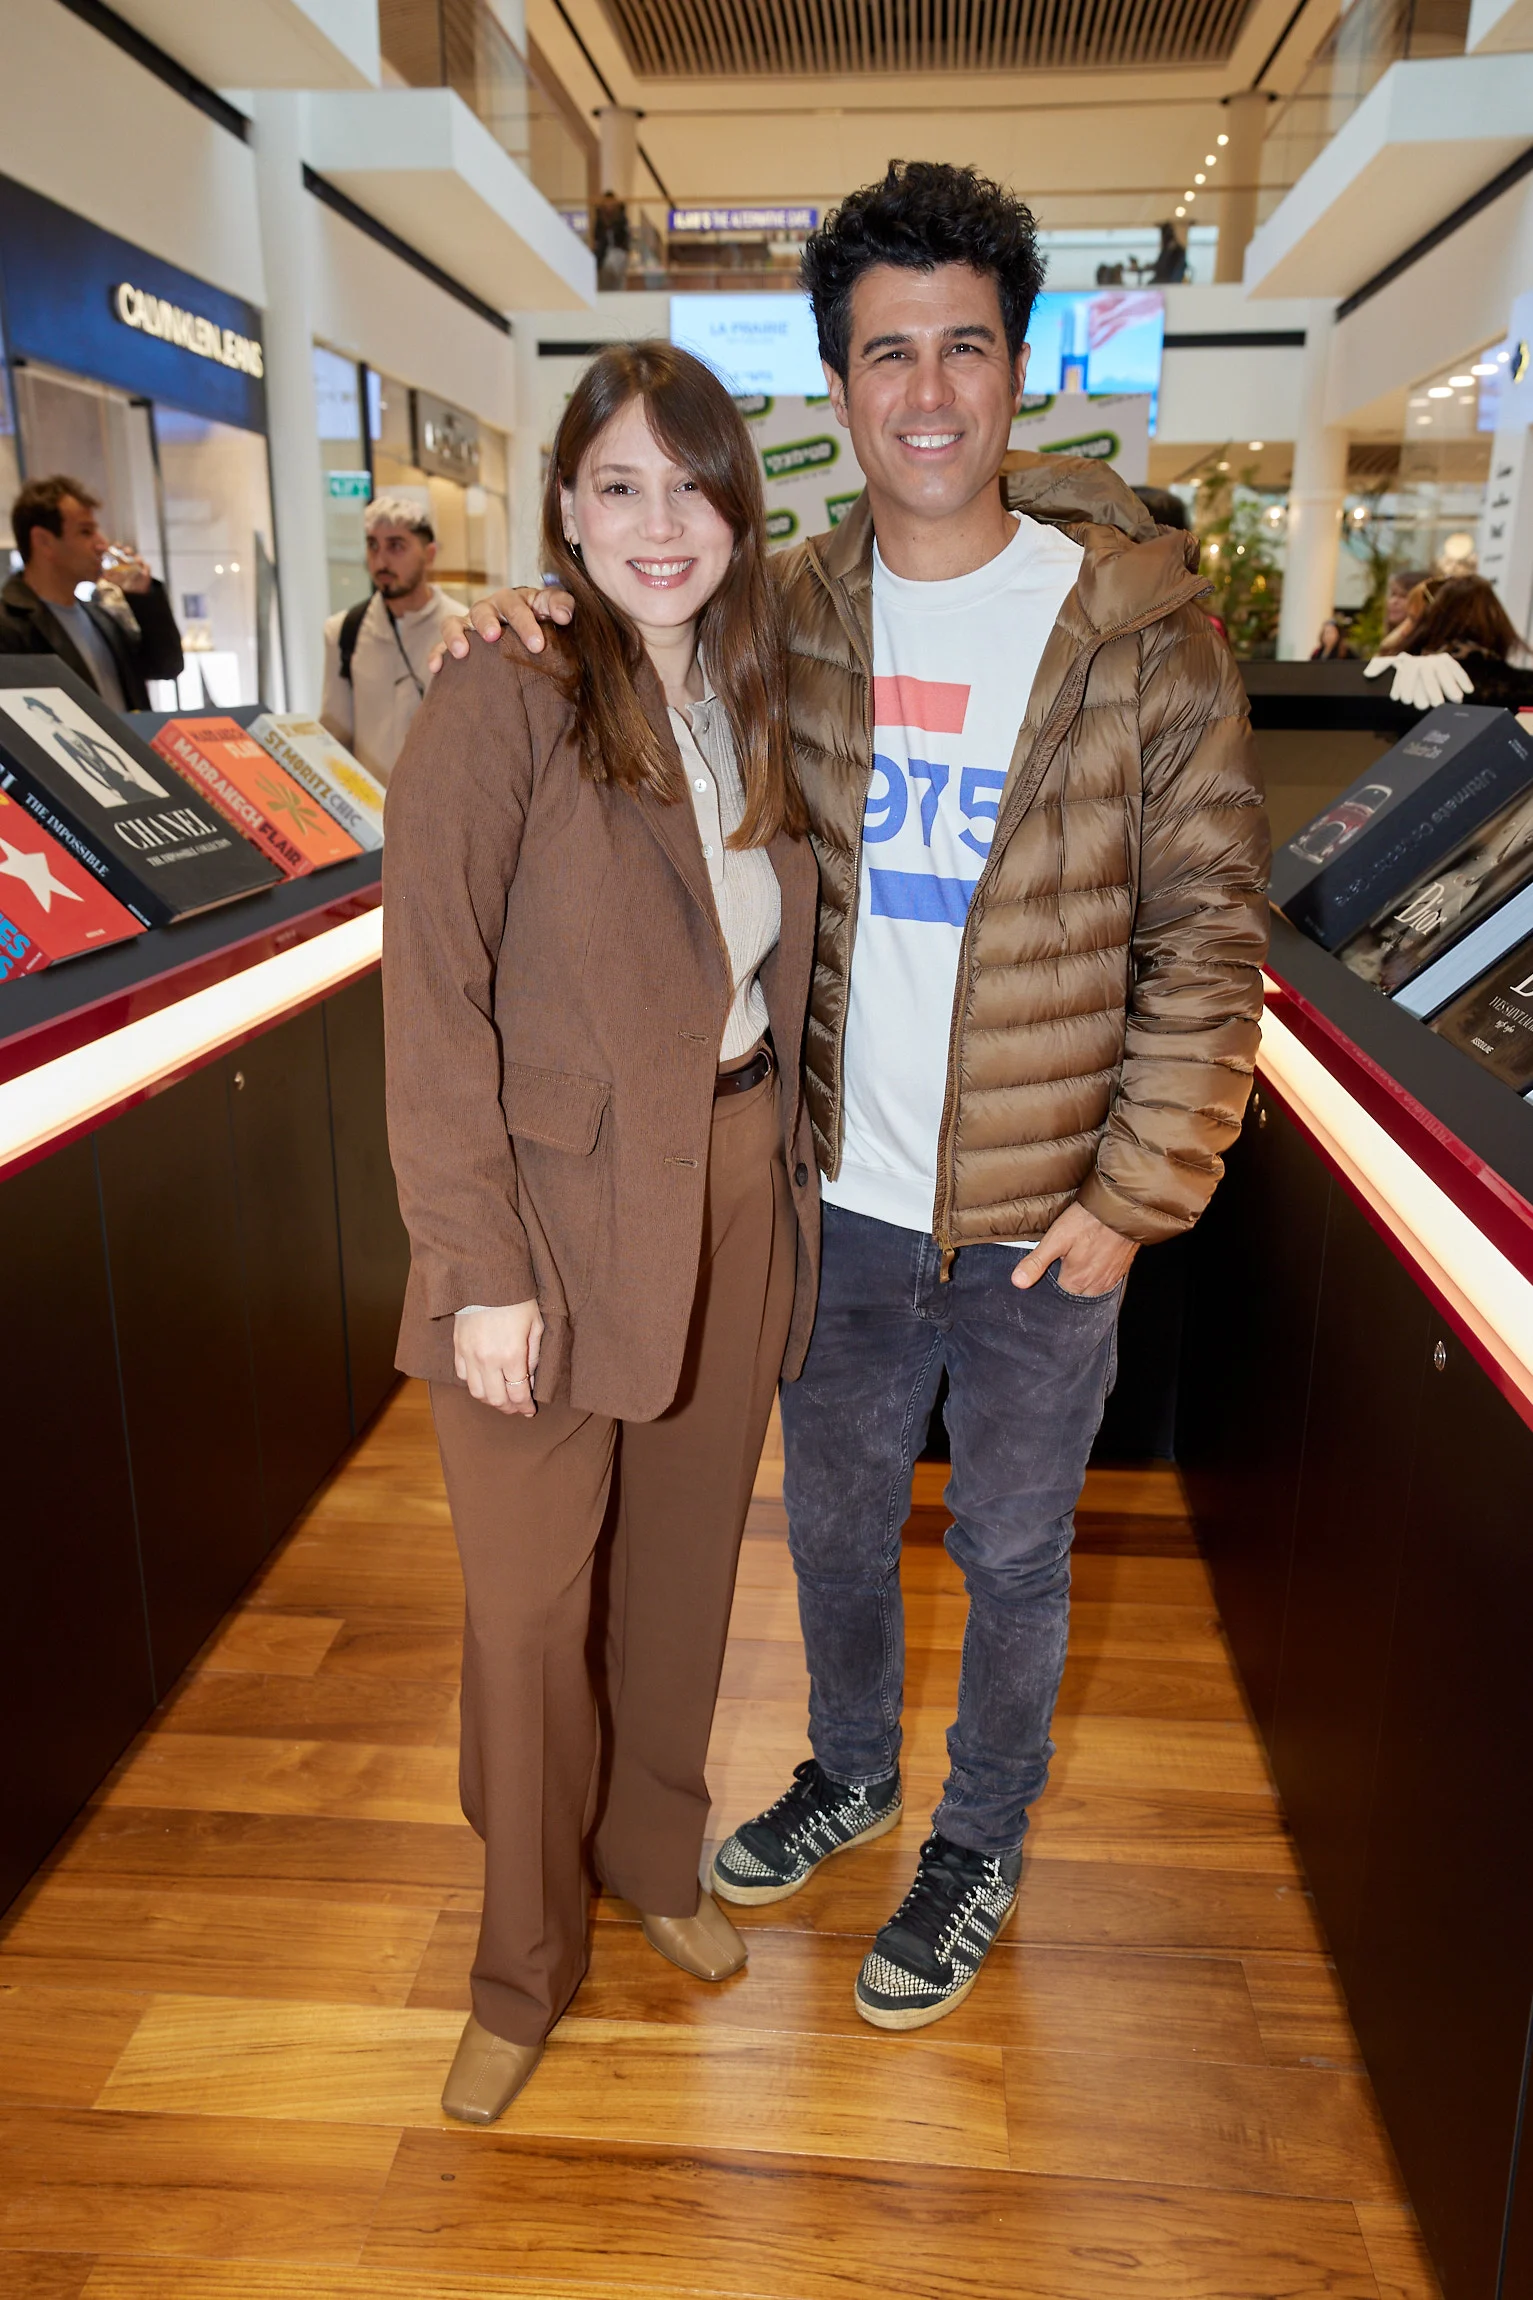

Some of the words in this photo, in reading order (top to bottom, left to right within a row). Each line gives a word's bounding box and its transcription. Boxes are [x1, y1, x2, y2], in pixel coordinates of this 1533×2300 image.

[172, 736, 265, 828] MARRAKECH
[258, 820, 302, 867] FLAIR
[281, 746, 334, 799] MORITZ
[329, 793, 363, 827] CHIC
[24, 792, 49, 820] THE
[47, 814, 111, 878] IMPOSSIBLE
[114, 807, 218, 851] CHANEL
[1393, 881, 1449, 936] Dior
